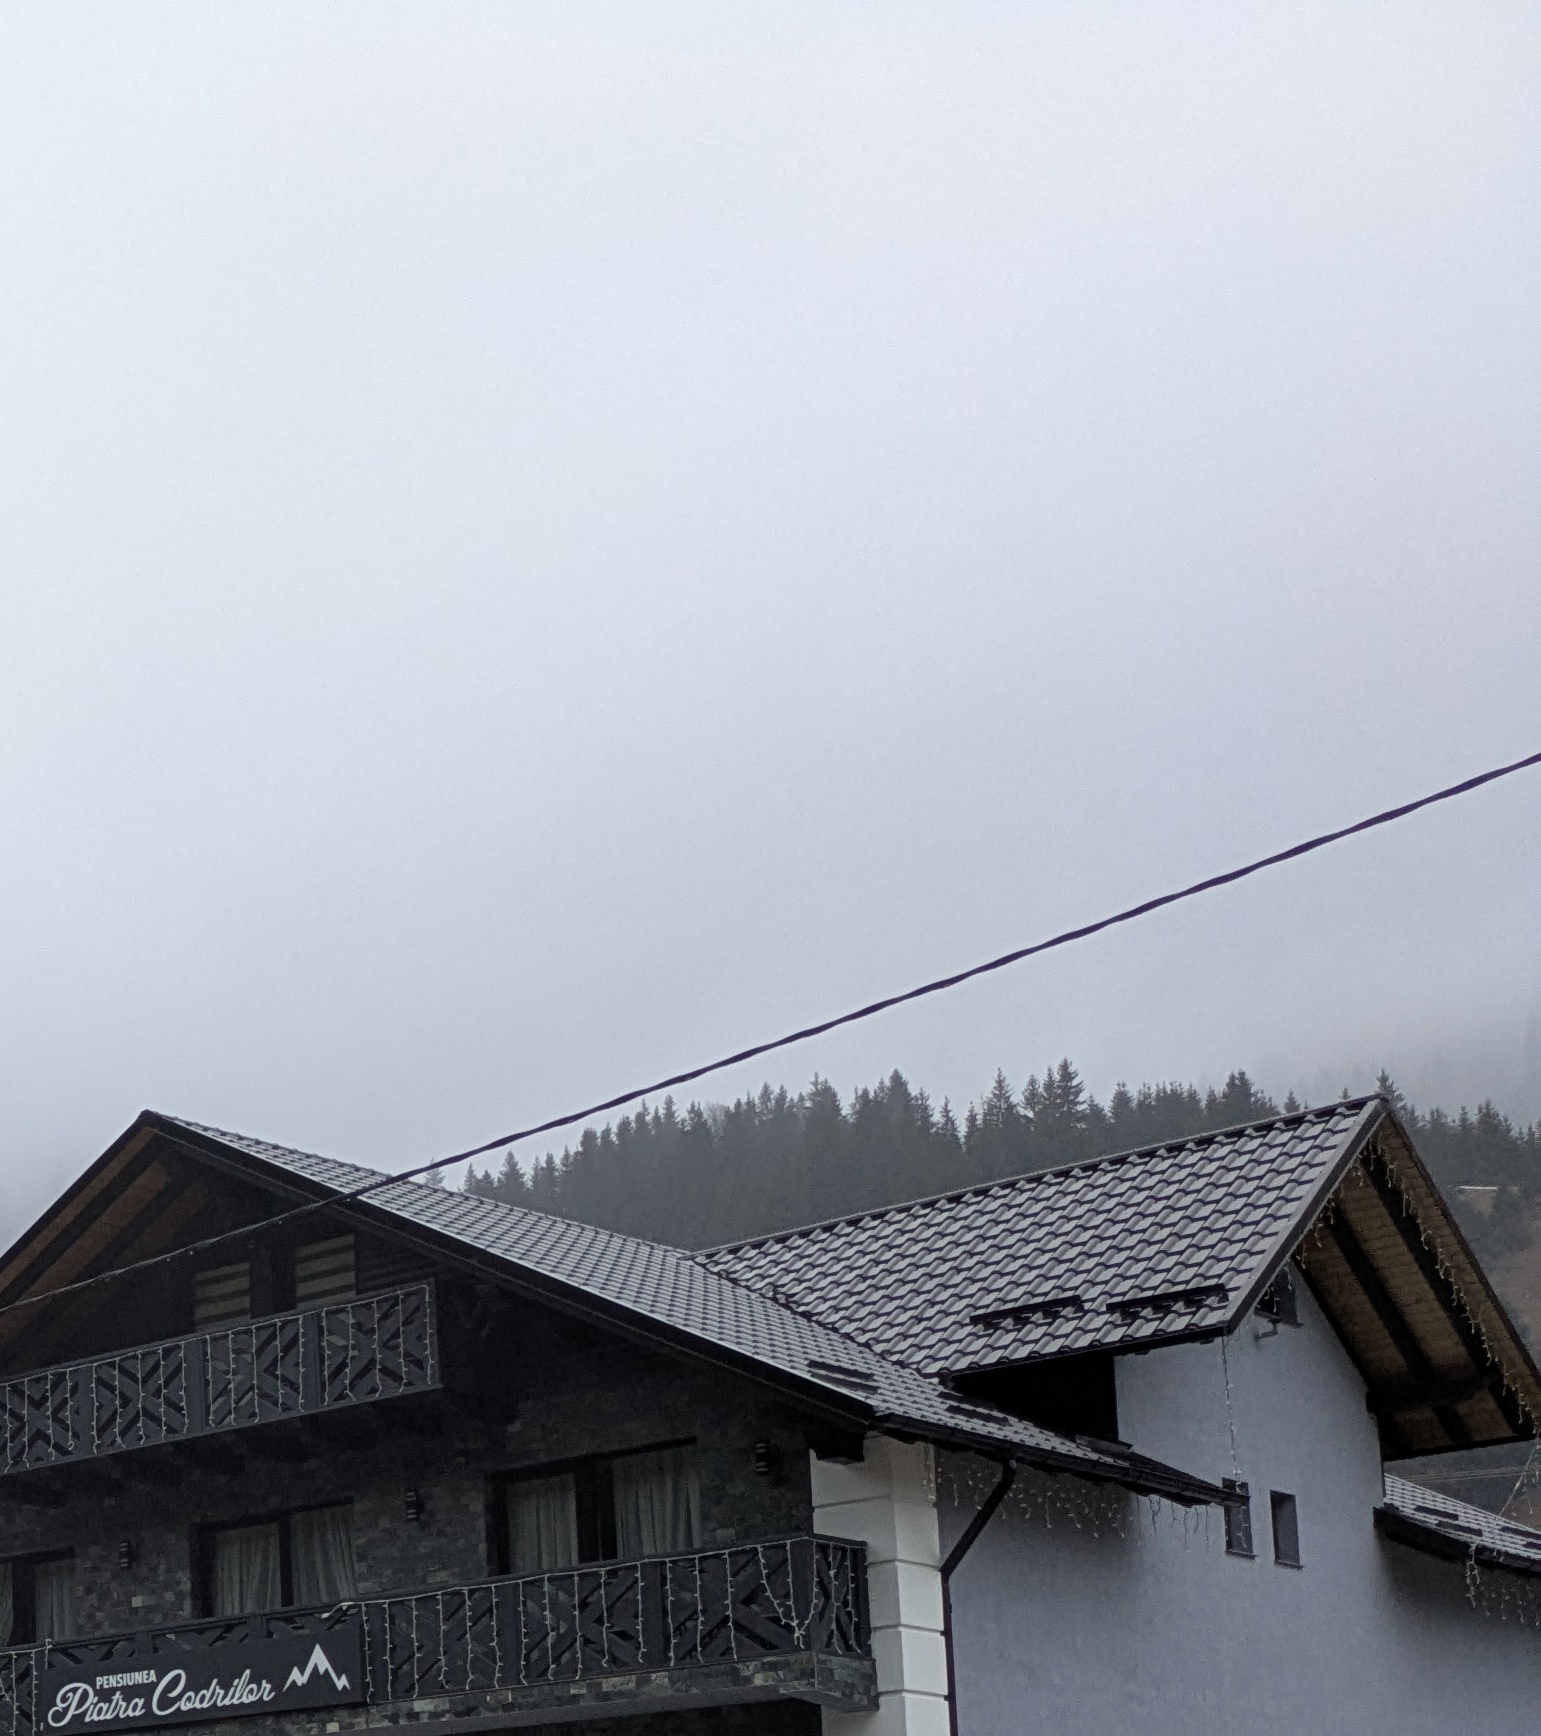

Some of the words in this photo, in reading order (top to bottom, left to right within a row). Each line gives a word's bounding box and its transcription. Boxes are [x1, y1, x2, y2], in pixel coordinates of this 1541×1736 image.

[47, 1682, 146, 1728] Piatra
[151, 1669, 276, 1716] Codrilor
[96, 1669, 156, 1689] PENSIUNEA
